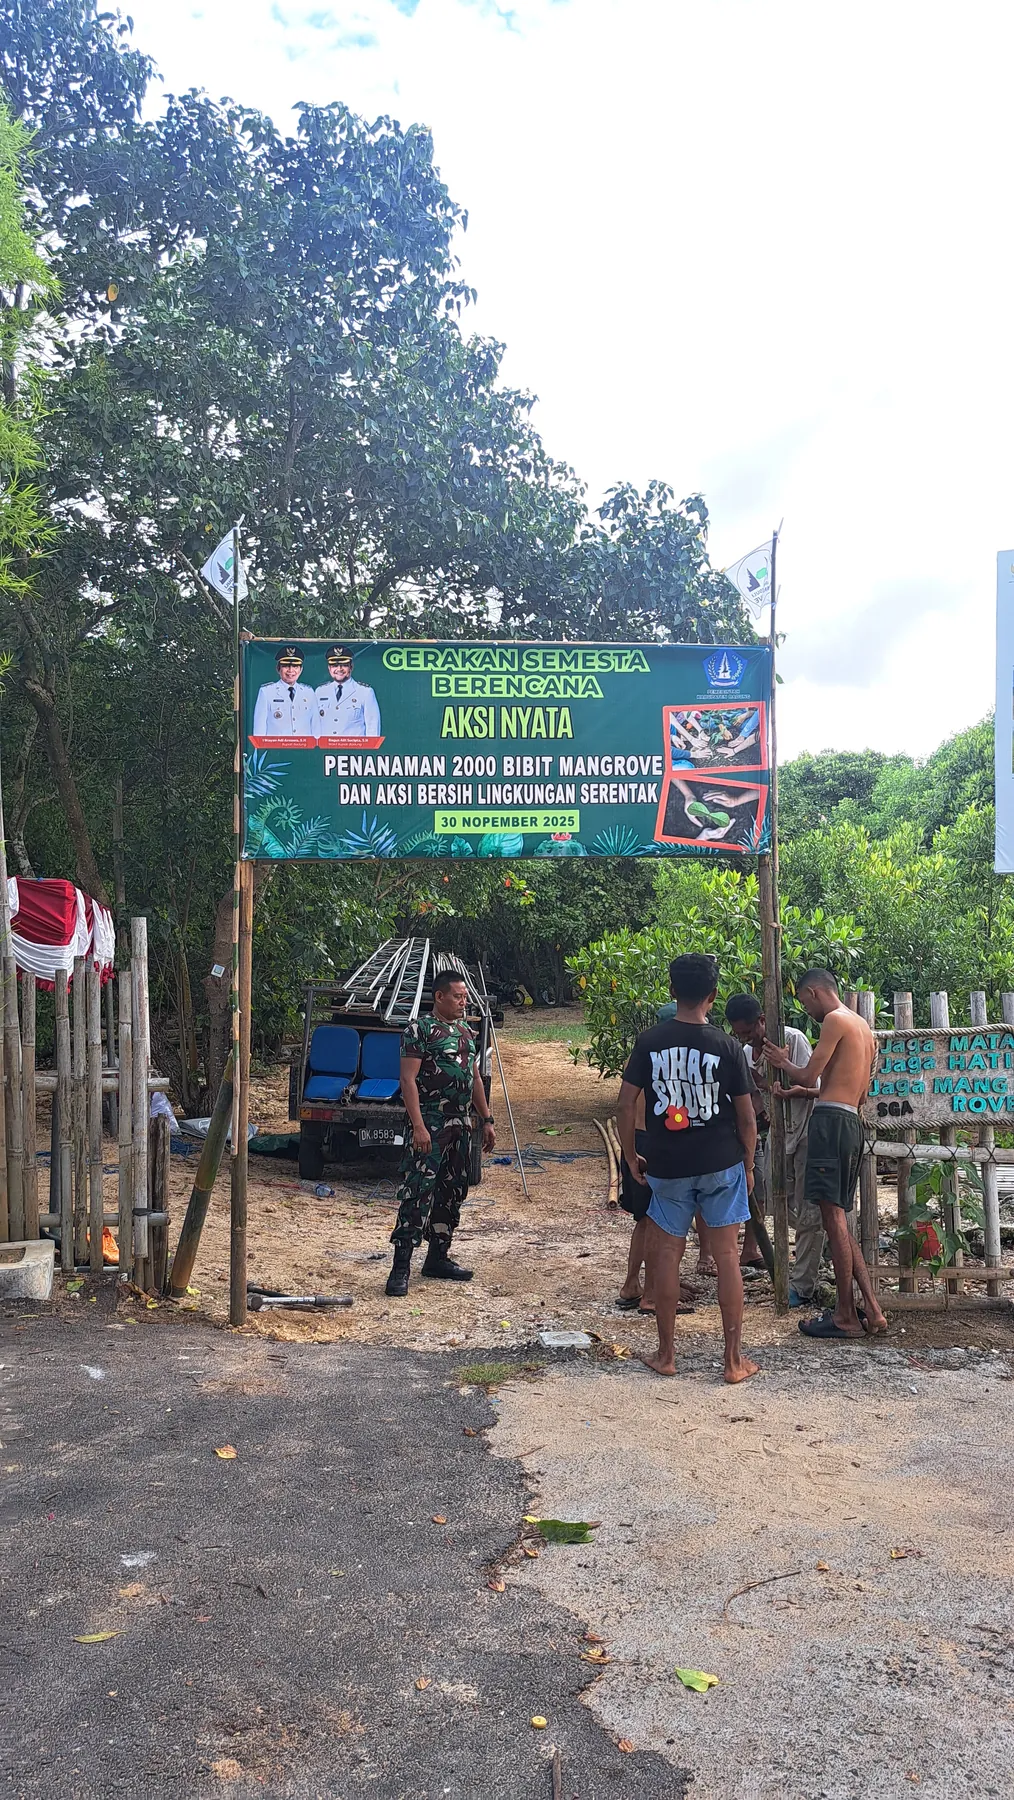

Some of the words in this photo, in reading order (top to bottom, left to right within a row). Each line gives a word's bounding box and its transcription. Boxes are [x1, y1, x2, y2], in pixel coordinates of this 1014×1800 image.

[382, 647, 518, 671] GERAKAN
[521, 649, 651, 672] SEMESTA
[431, 674, 604, 698] BERENCANA
[441, 706, 495, 738] AKSI
[500, 706, 574, 739] NYATA
[324, 755, 446, 777] PENANAMAN
[452, 755, 496, 777] 2000
[503, 756, 553, 777] BIBIT
[559, 755, 663, 776] MANGROVE
[339, 784, 371, 805] DAN
[376, 784, 412, 805] AKSI
[417, 784, 473, 805] BERSIH
[477, 783, 576, 805] LINGKUNGAN
[580, 782, 658, 804] SERENTAK
[441, 816, 457, 828] 30
[462, 816, 538, 828] NOPEMBER
[543, 816, 575, 828] 2025
[880, 1037, 935, 1056] Jaga
[949, 1033, 1014, 1052] MATA
[649, 1046, 721, 1085] WHAT
[880, 1056, 937, 1075] Jaga
[948, 1052, 1012, 1071] HATI
[868, 1079, 926, 1098] Jaga
[933, 1076, 1009, 1095] MANG
[877, 1100, 914, 1117] SGA
